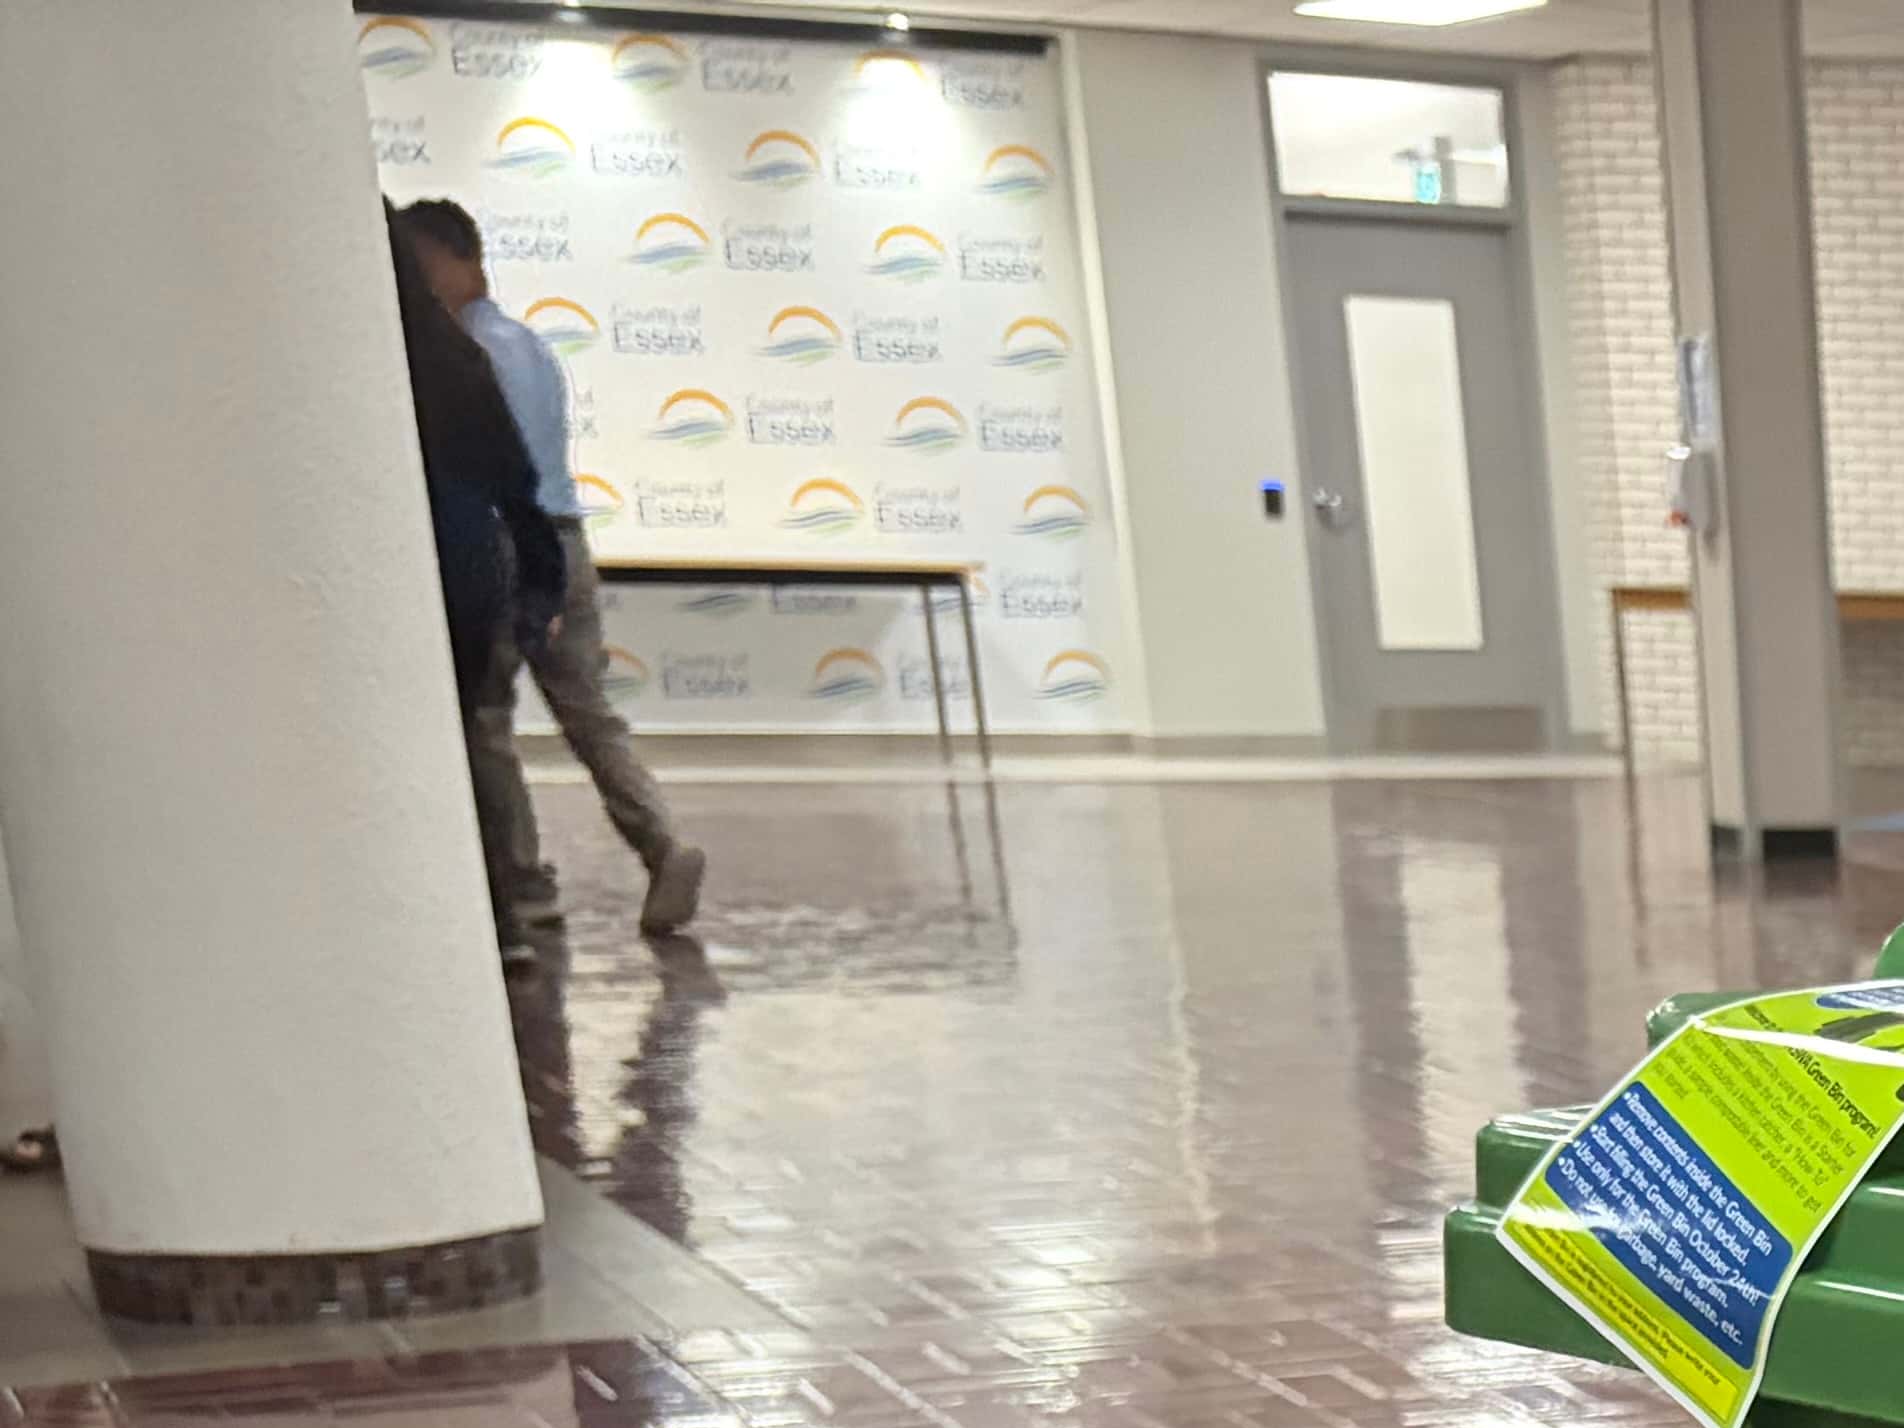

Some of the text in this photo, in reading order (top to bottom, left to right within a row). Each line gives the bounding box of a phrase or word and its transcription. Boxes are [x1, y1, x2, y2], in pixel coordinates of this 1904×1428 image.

[1559, 1159, 1582, 1181] Do
[1571, 1175, 1594, 1198] not
[1654, 1262, 1685, 1294] yard
[1718, 1317, 1747, 1348] etc.
[1573, 1144, 1732, 1313] Use only for the Green Bin program.
[1590, 1126, 1617, 1153] Start
[1629, 1168, 1652, 1192] the
[1642, 1183, 1679, 1220] Green
[1670, 1211, 1695, 1238] Bin
[1686, 1228, 1732, 1278] October
[1607, 1110, 1753, 1267] and then store it with the lid locked.
[1650, 1124, 1692, 1167] contents
[1683, 1158, 1716, 1192] inside
[1706, 1184, 1730, 1209] the
[1722, 1199, 1758, 1238] Green
[1750, 1228, 1776, 1256] Bin
